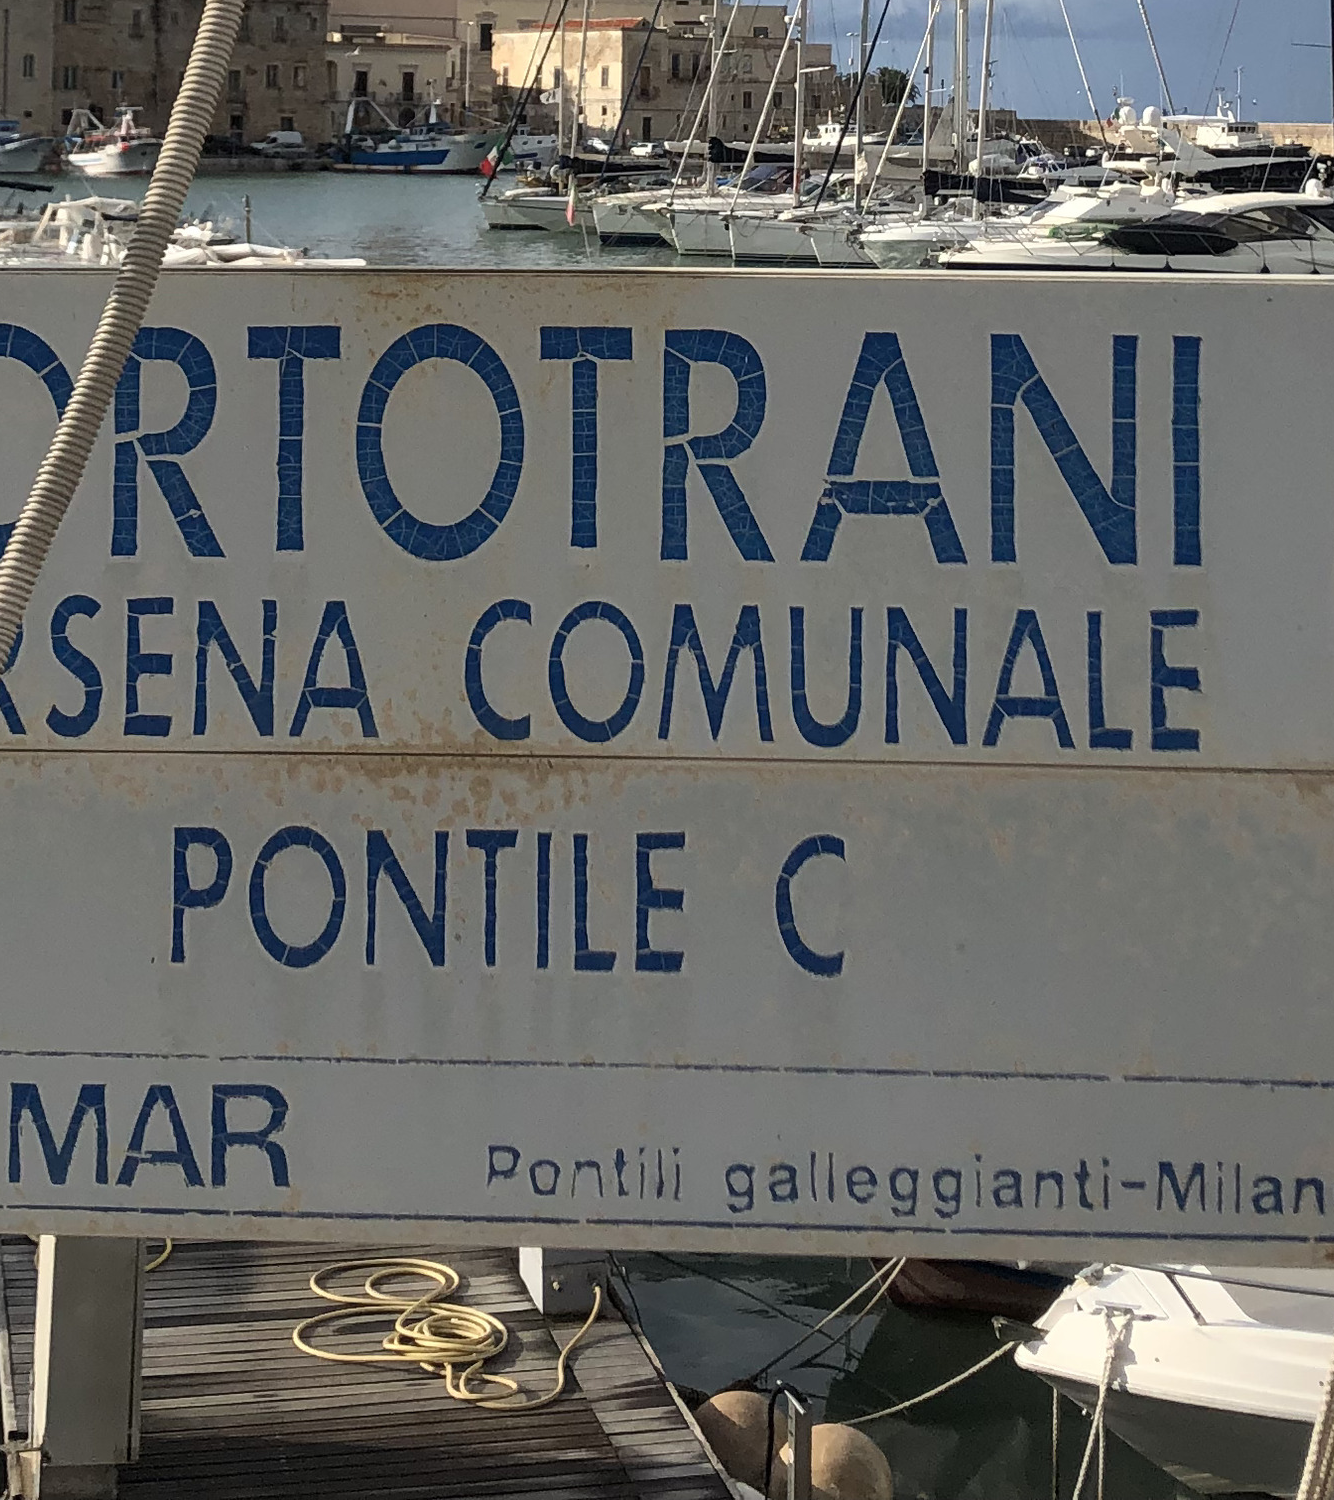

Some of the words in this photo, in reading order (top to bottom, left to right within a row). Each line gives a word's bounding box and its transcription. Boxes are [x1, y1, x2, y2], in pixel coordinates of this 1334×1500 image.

[464, 598, 1201, 752] COMUNALE
[171, 826, 685, 974] PONTILE
[775, 835, 846, 976] C
[486, 1144, 681, 1201] Pontili
